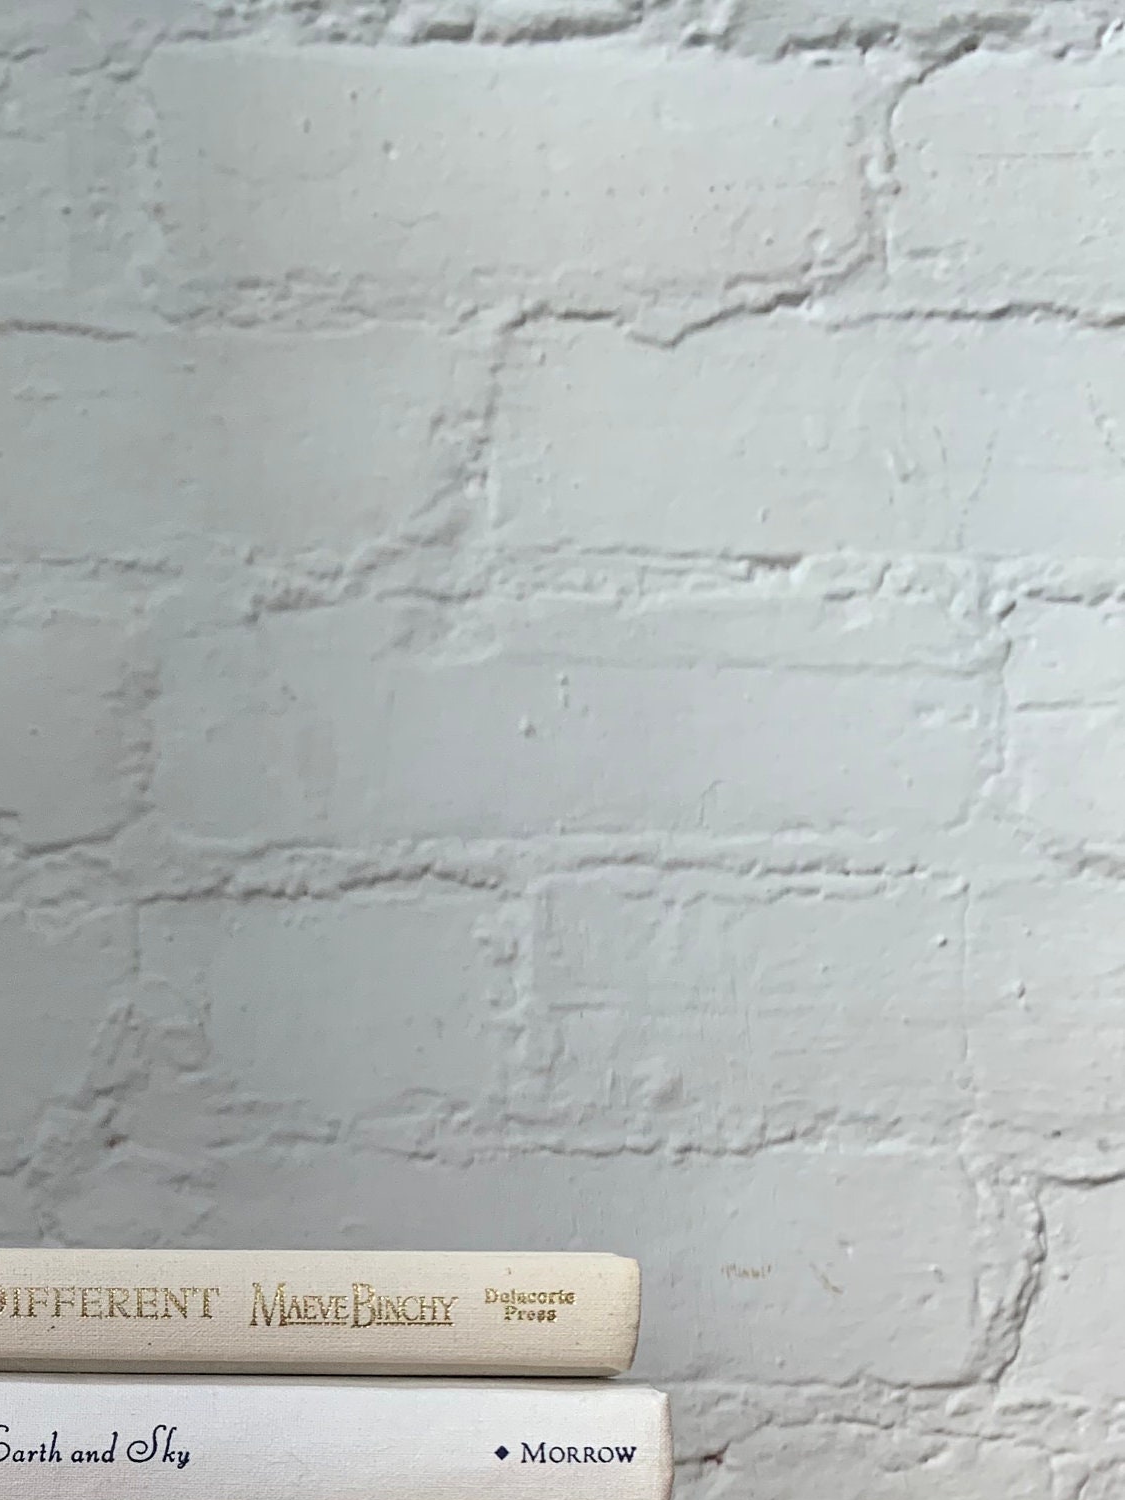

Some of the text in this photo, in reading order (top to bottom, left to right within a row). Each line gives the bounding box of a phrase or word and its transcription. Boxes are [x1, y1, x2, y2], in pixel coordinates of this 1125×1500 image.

[484, 1287, 576, 1305] Delacorte
[503, 1306, 557, 1323] Press
[71, 1432, 117, 1464] and
[126, 1424, 190, 1473] Sky
